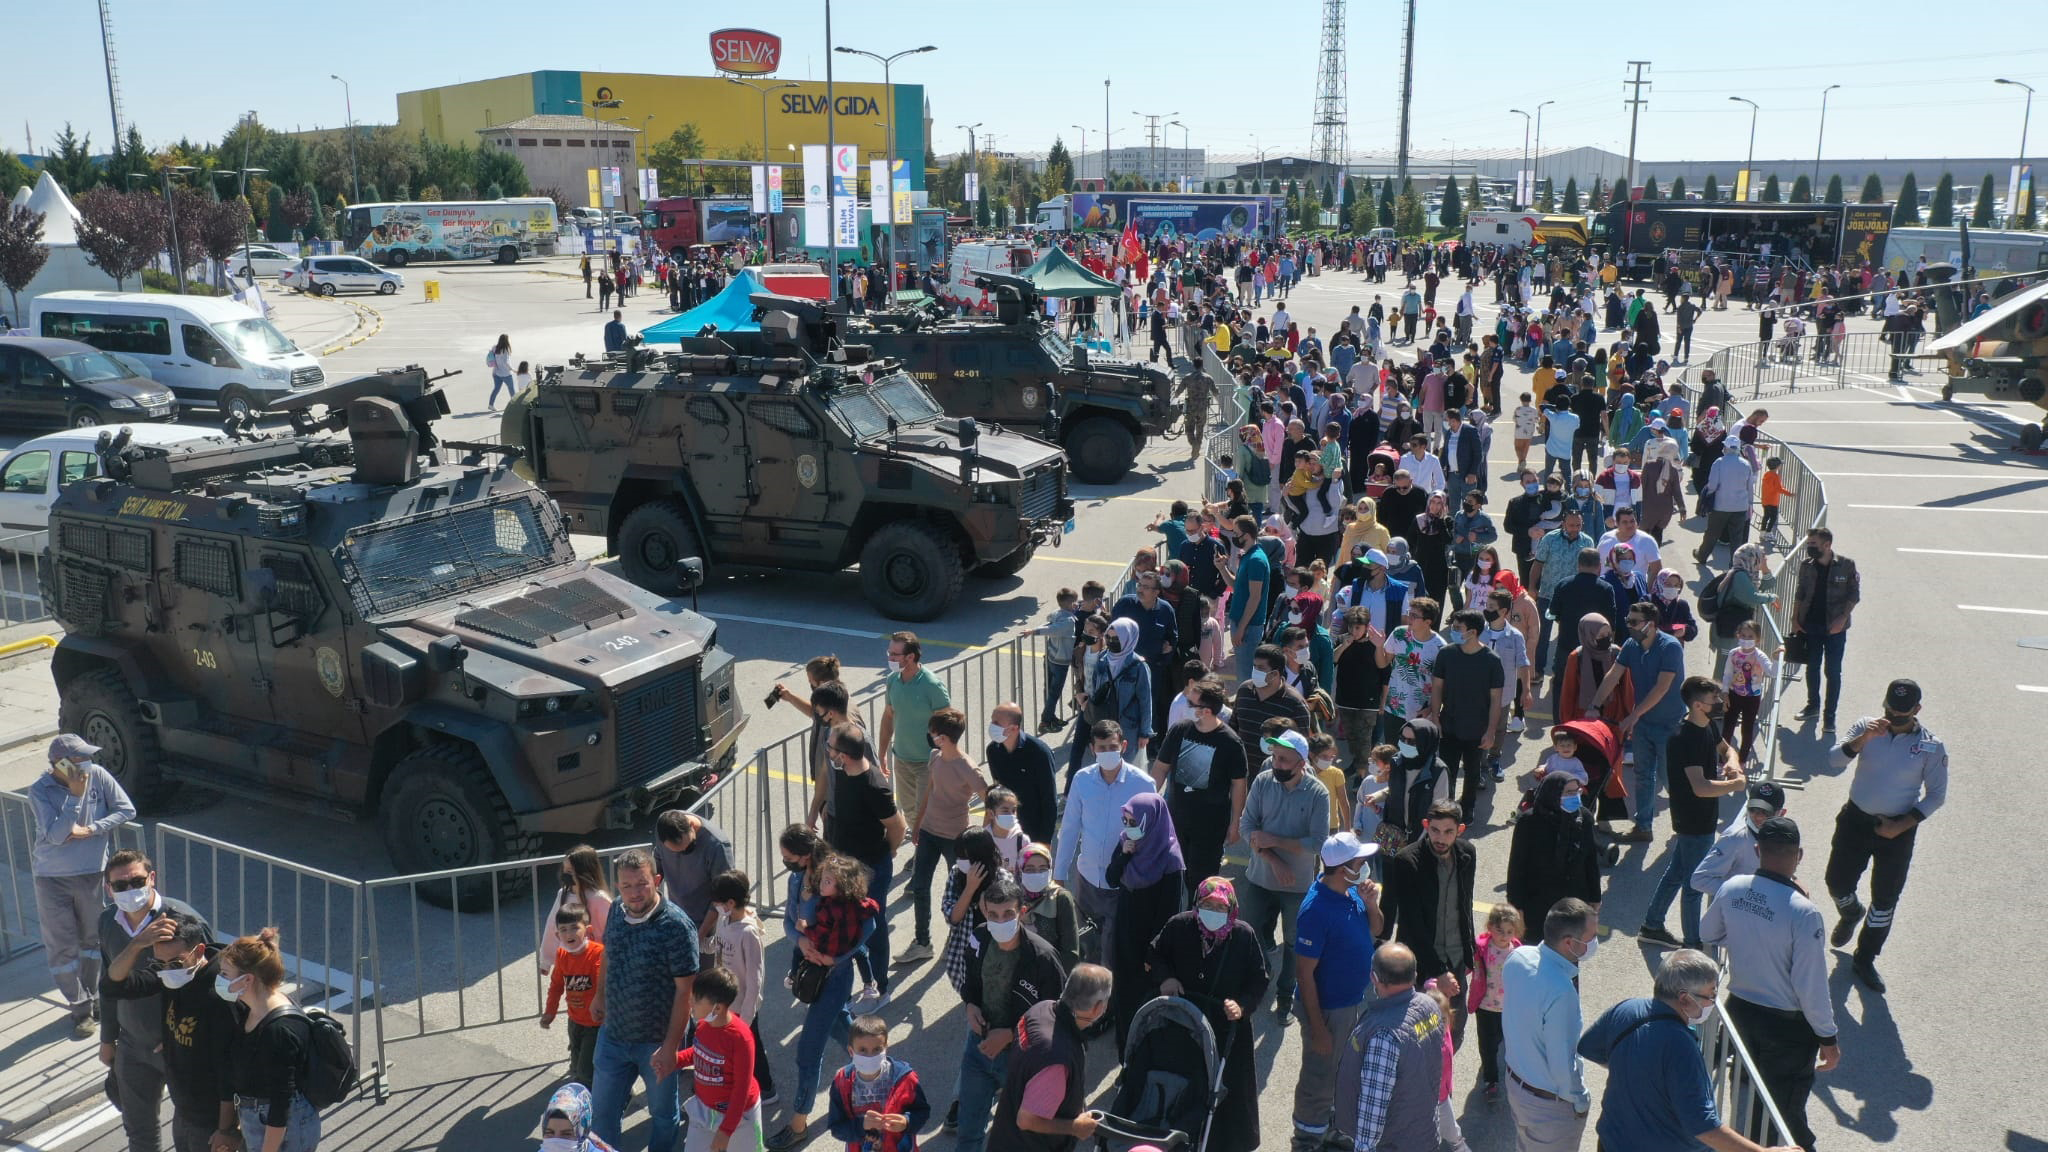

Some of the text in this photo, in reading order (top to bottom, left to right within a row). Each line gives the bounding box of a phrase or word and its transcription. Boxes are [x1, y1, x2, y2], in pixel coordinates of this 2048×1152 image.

[716, 38, 775, 64] SELVA
[834, 96, 880, 116] GIDA
[427, 208, 441, 217] Gez
[840, 209, 848, 234] BİLİM
[953, 369, 980, 378] 42-01
[141, 498, 173, 519] AHMET
[193, 648, 217, 669] 2-03
